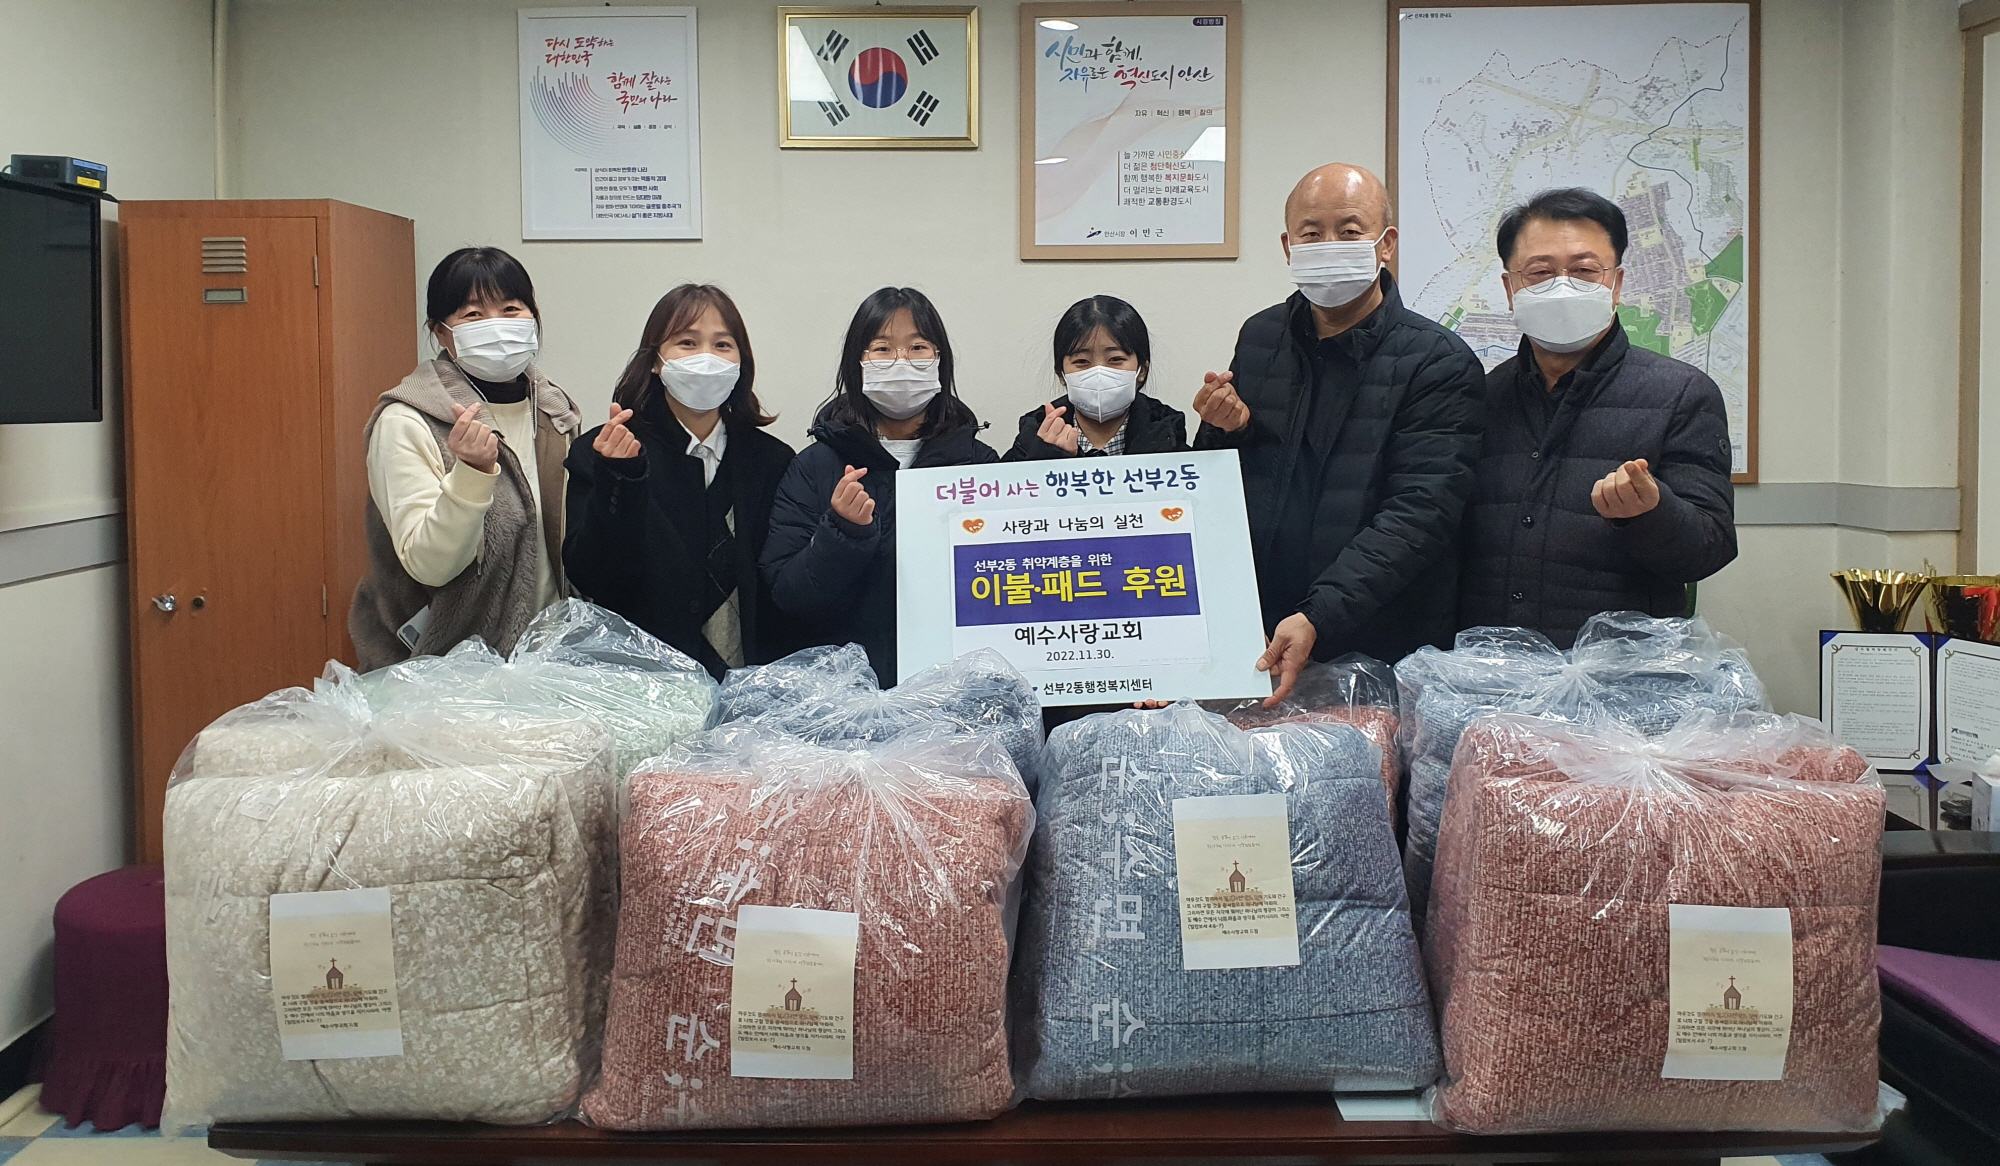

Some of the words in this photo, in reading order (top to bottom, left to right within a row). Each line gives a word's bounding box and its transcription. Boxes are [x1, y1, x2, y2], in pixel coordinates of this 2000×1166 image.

[545, 36, 570, 50] 다시
[575, 36, 614, 50] 도약하는
[545, 51, 593, 67] 대한민국
[1045, 36, 1102, 70] 시민과
[607, 72, 637, 90] 함께
[640, 71, 671, 90] 잘사는
[1059, 66, 1109, 93] 자유로운
[1113, 65, 1174, 90] 혁신도시
[1177, 66, 1214, 83] 안산
[616, 91, 647, 114] 국민의
[651, 91, 678, 109] 나라
[1135, 109, 1148, 117] 자유
[1199, 108, 1213, 116] 창의
[1124, 151, 1130, 159] 늘
[1133, 151, 1155, 159] 가까운
[1124, 162, 1130, 171] 더
[1133, 162, 1147, 171] 젊은
[1150, 162, 1195, 171] 첨단혁신도시
[1124, 173, 1138, 182] 함께
[1140, 173, 1163, 182] 행복한
[1164, 173, 1209, 183] 복지문화도시
[1124, 186, 1130, 194] 더
[1133, 185, 1163, 194] 멀리보는
[1164, 185, 1209, 194] 미래교육도시
[1124, 197, 1146, 206] 쾌적한
[1148, 197, 1192, 206] 교통환경도시
[936, 477, 1000, 505] 더불어
[1006, 478, 1040, 498] 사는
[1045, 468, 1115, 498] 행복한
[1123, 463, 1200, 493] 선부2동
[1002, 518, 1050, 534] 사랑과
[1058, 515, 1105, 532] 나눔의
[1114, 513, 1144, 530] 실천
[973, 559, 1017, 573] 선부2동
[1022, 555, 1082, 570] 취약계층을
[1088, 553, 1113, 566] 위한
[1122, 564, 1187, 599] 후원
[1014, 621, 1143, 646] 예수사랑교회
[1046, 649, 1115, 662] 2022.11.30.
[1043, 678, 1153, 696] 선부2동행정복지센터
